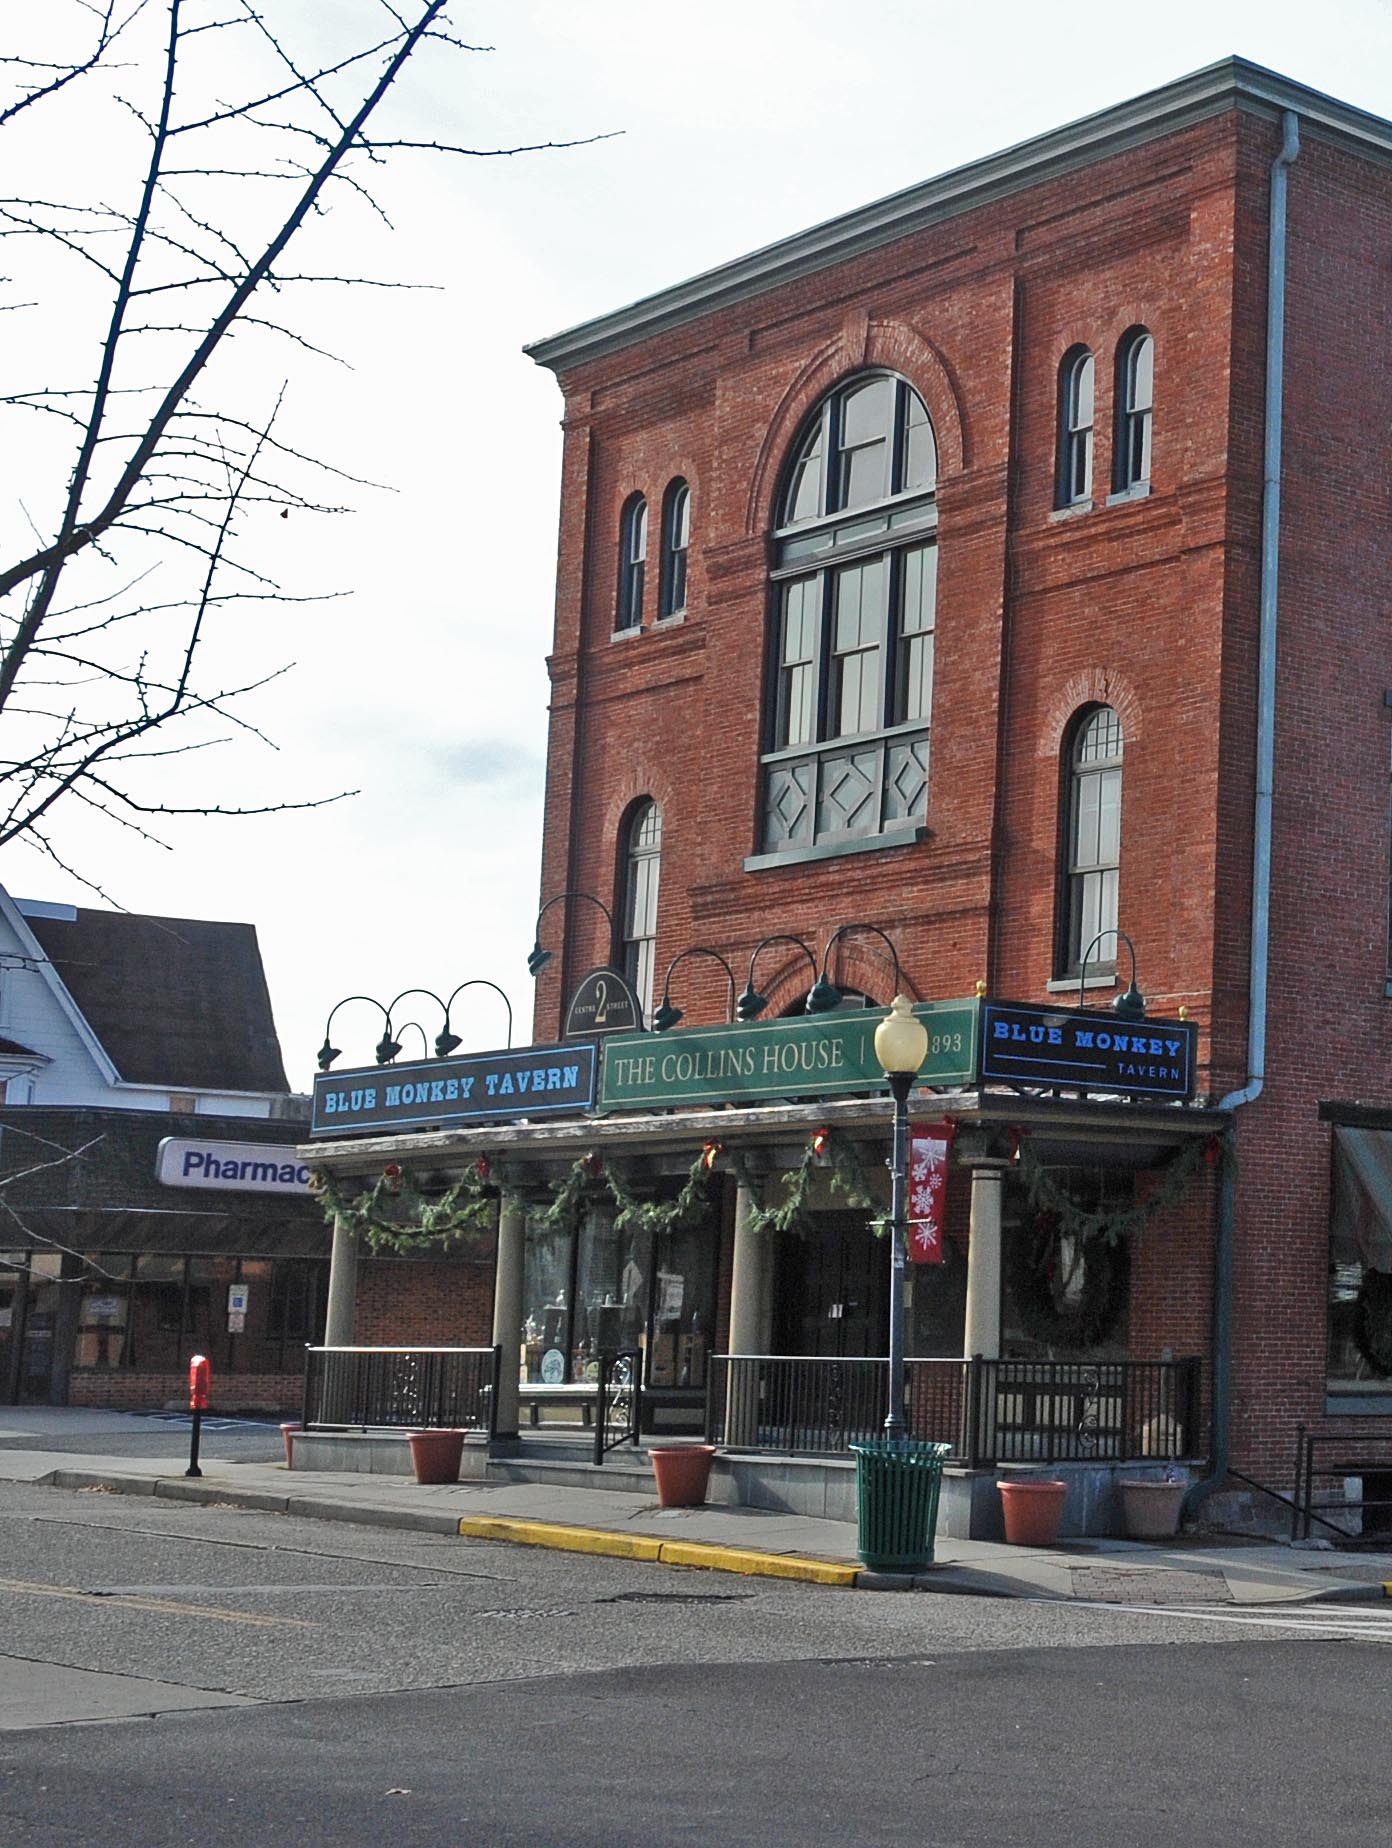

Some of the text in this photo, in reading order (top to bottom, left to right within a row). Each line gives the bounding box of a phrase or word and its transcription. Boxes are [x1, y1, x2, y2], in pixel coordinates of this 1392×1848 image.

[595, 980, 607, 1023] 2
[993, 1022, 1181, 1057] BLUE MONKEY
[614, 1033, 962, 1087] THE COLLINS HOUSE 893
[1118, 1062, 1180, 1080] TAVERN
[324, 1066, 579, 1113] BLUE MONKEY TAVERN
[182, 1151, 311, 1185] Pharmac
